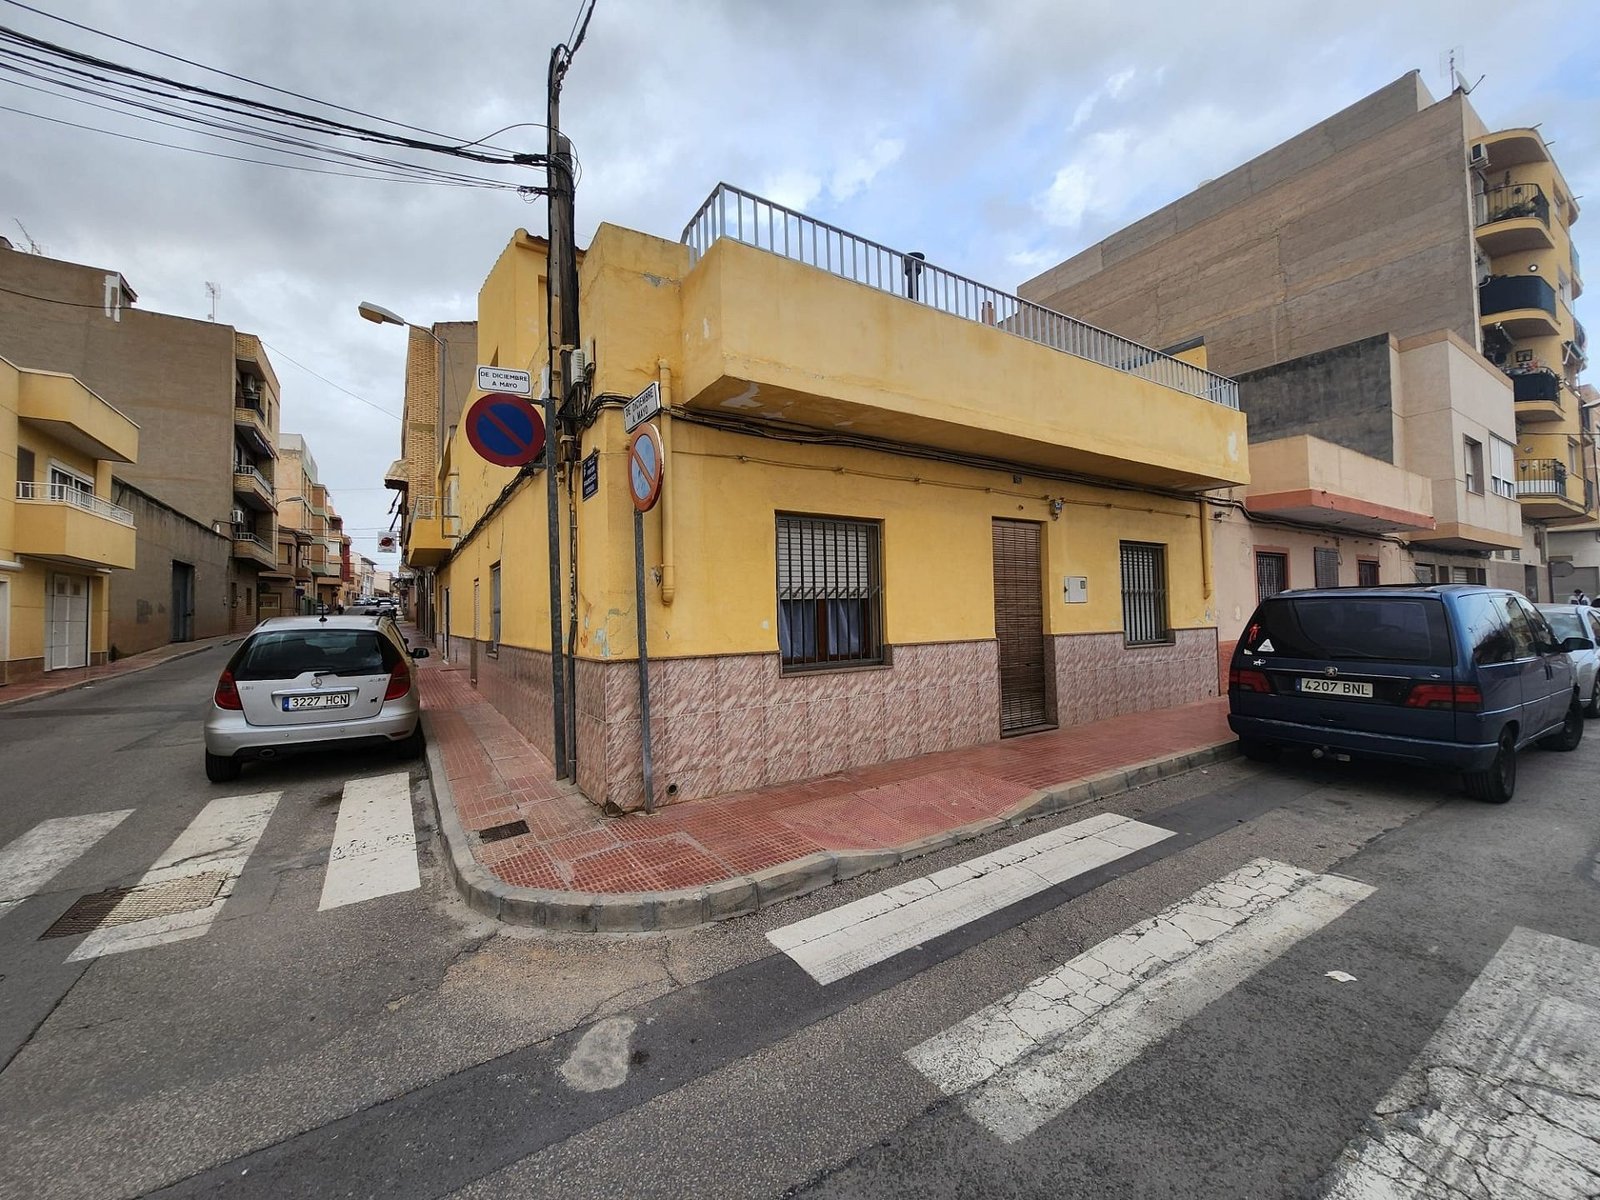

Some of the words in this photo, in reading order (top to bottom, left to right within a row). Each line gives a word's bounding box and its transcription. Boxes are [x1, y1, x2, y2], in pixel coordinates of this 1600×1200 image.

[492, 372, 528, 382] DICIEMBRE
[499, 381, 518, 389] MAYO
[1304, 680, 1338, 692] 4207
[1342, 682, 1370, 696] BNL
[292, 696, 321, 707] 3227
[325, 694, 347, 705] HCN
